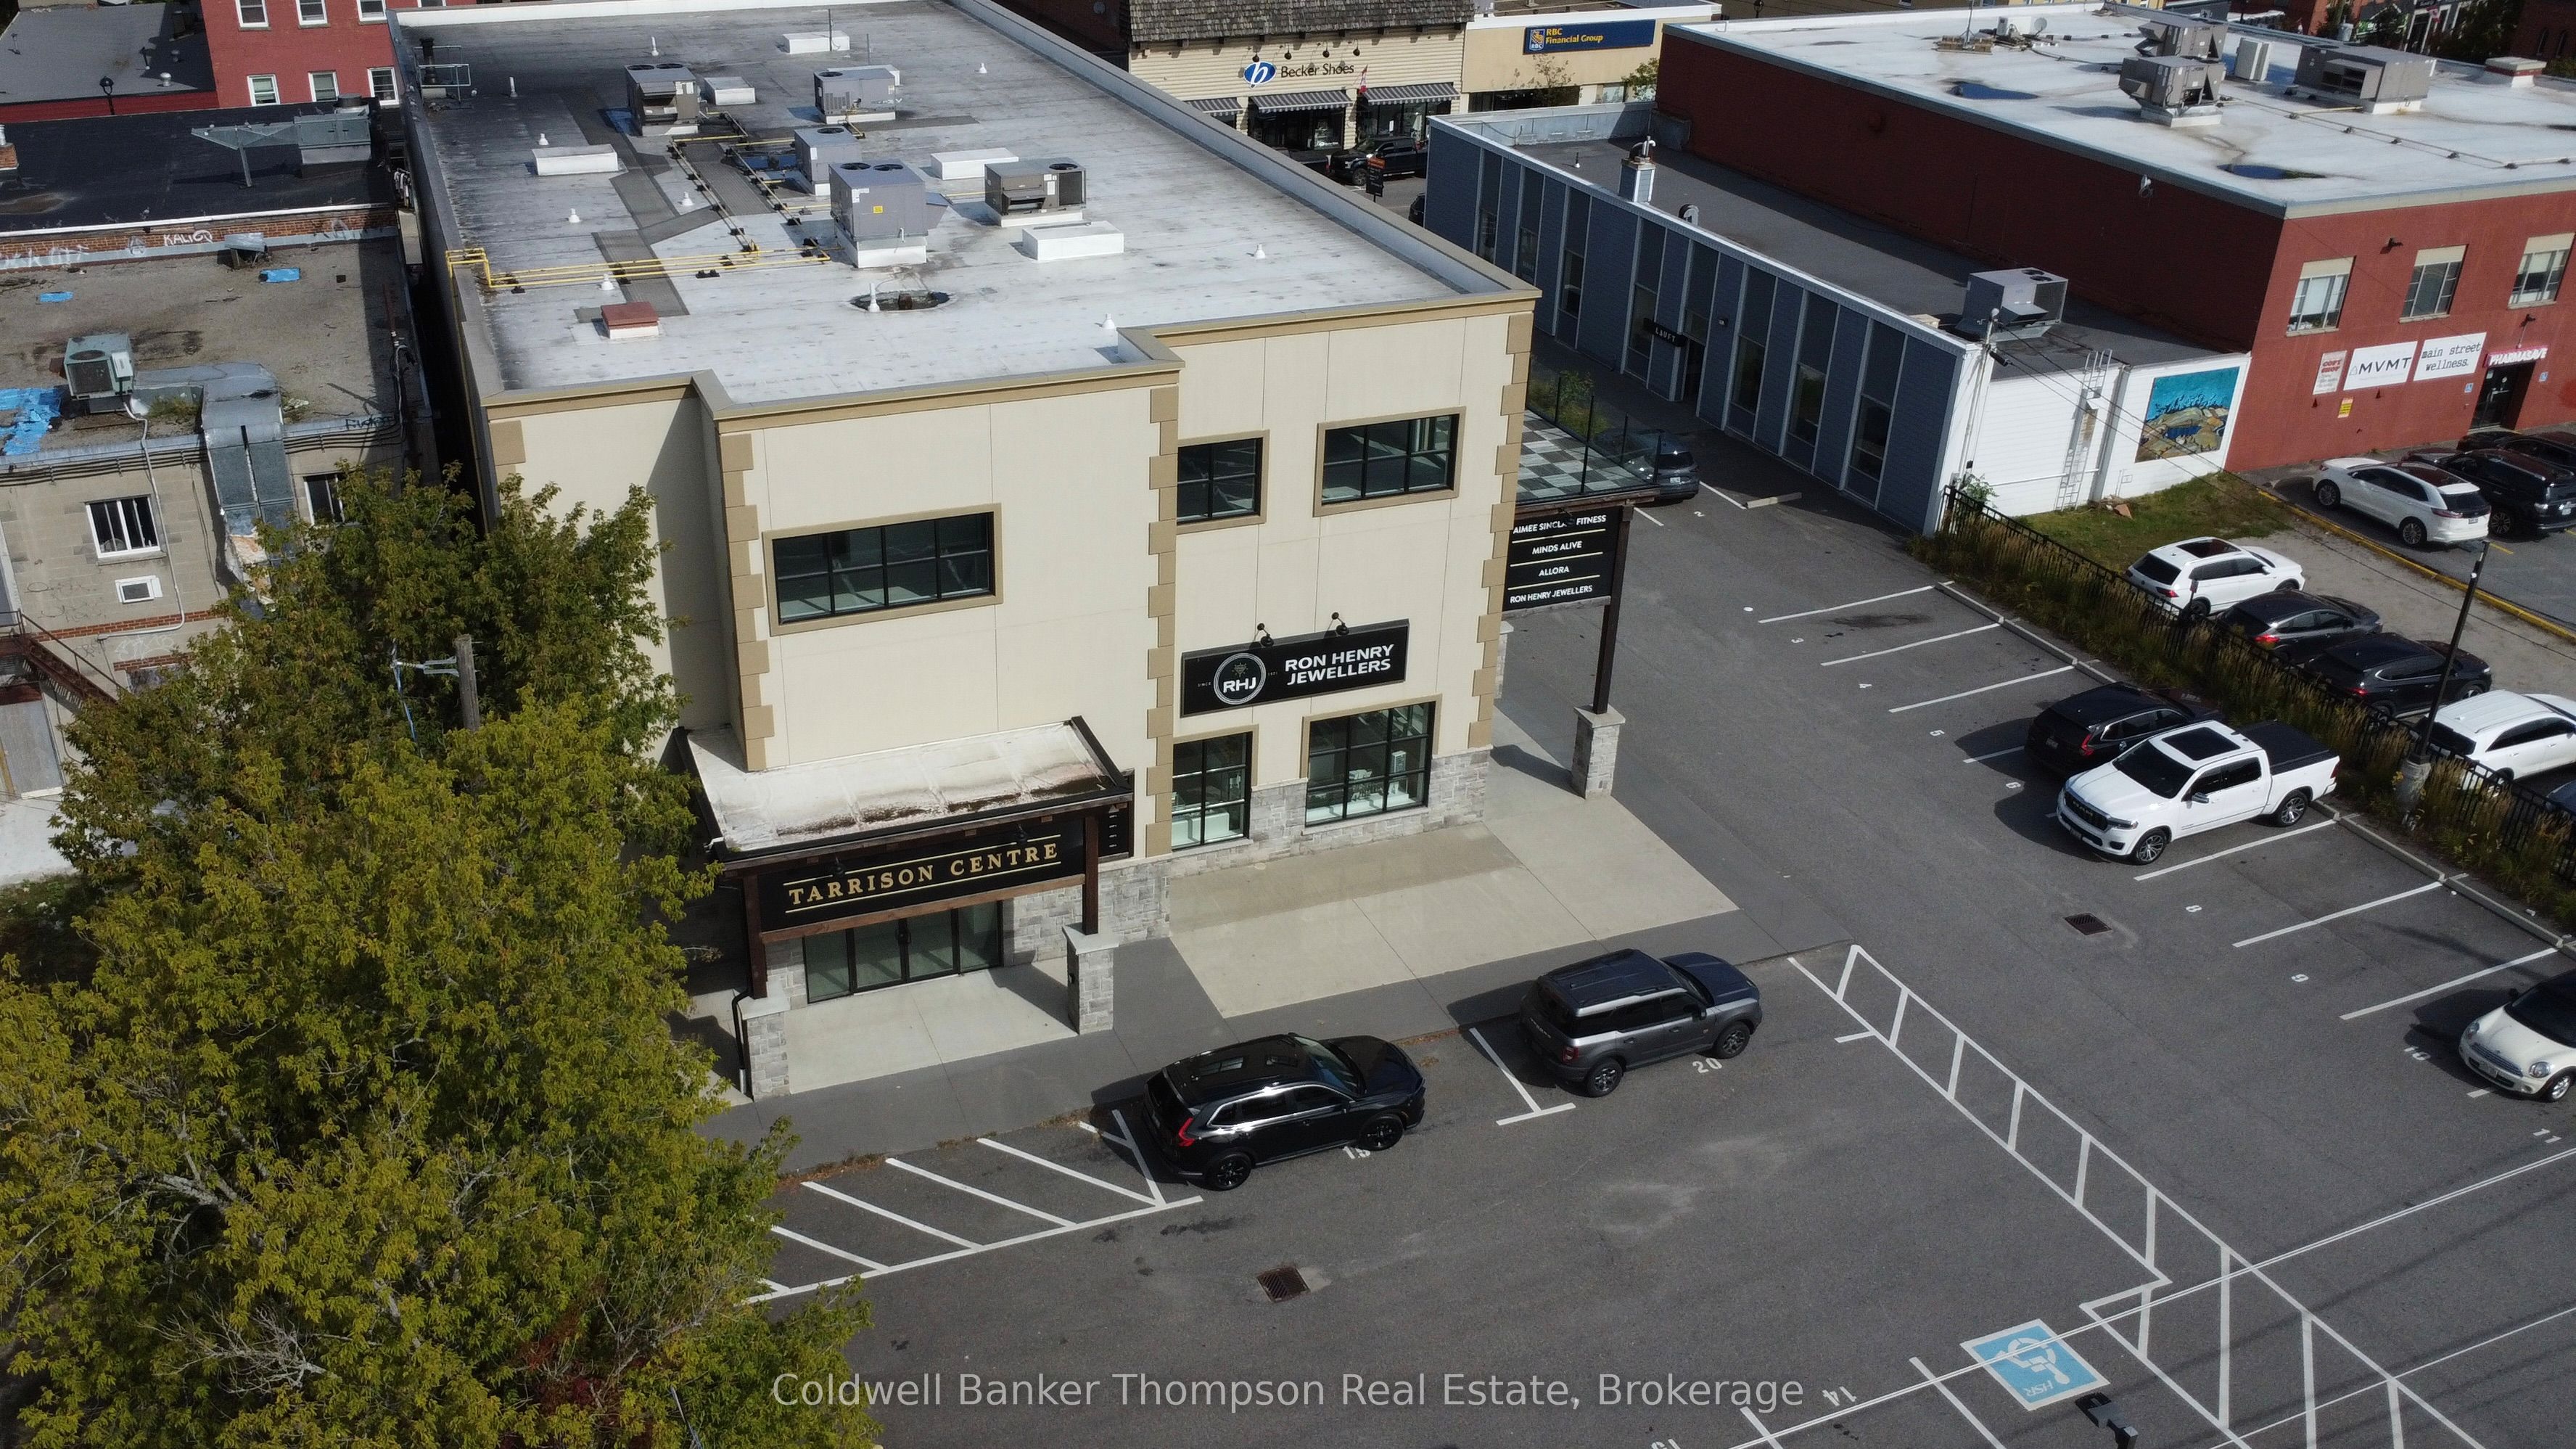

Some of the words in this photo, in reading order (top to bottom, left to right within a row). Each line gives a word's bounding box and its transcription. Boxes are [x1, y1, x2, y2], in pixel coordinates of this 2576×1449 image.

[1546, 35, 1579, 44] Financial
[1581, 34, 1603, 43] Group
[1280, 65, 1320, 78] Becker
[1322, 63, 1354, 75] Shoes
[2421, 348, 2443, 358] main
[2449, 343, 2482, 356] street
[2358, 356, 2412, 375] MVMT
[1513, 524, 1538, 534] AIMEE
[1539, 520, 1570, 530] SINCLA
[1576, 514, 1607, 525] FITNESS
[1531, 543, 1559, 554] MINDS
[1560, 541, 1582, 551] ALIVE
[1538, 566, 1570, 577] ALLORA
[1510, 594, 1527, 604] RON
[1527, 591, 1552, 602] HENRY
[1551, 584, 1593, 598] JEWELLERS
[1285, 654, 1327, 671] RON
[1331, 644, 1394, 665] HENRY
[1286, 658, 1391, 686] JEWELLERS
[1222, 676, 1256, 693] RHJ
[789, 864, 934, 906] TARRISON
[950, 842, 1058, 877] CENTRE
[1692, 1057, 1723, 1073] 20
[2532, 1128, 2562, 1144] 11
[1822, 1386, 1857, 1406] 14
